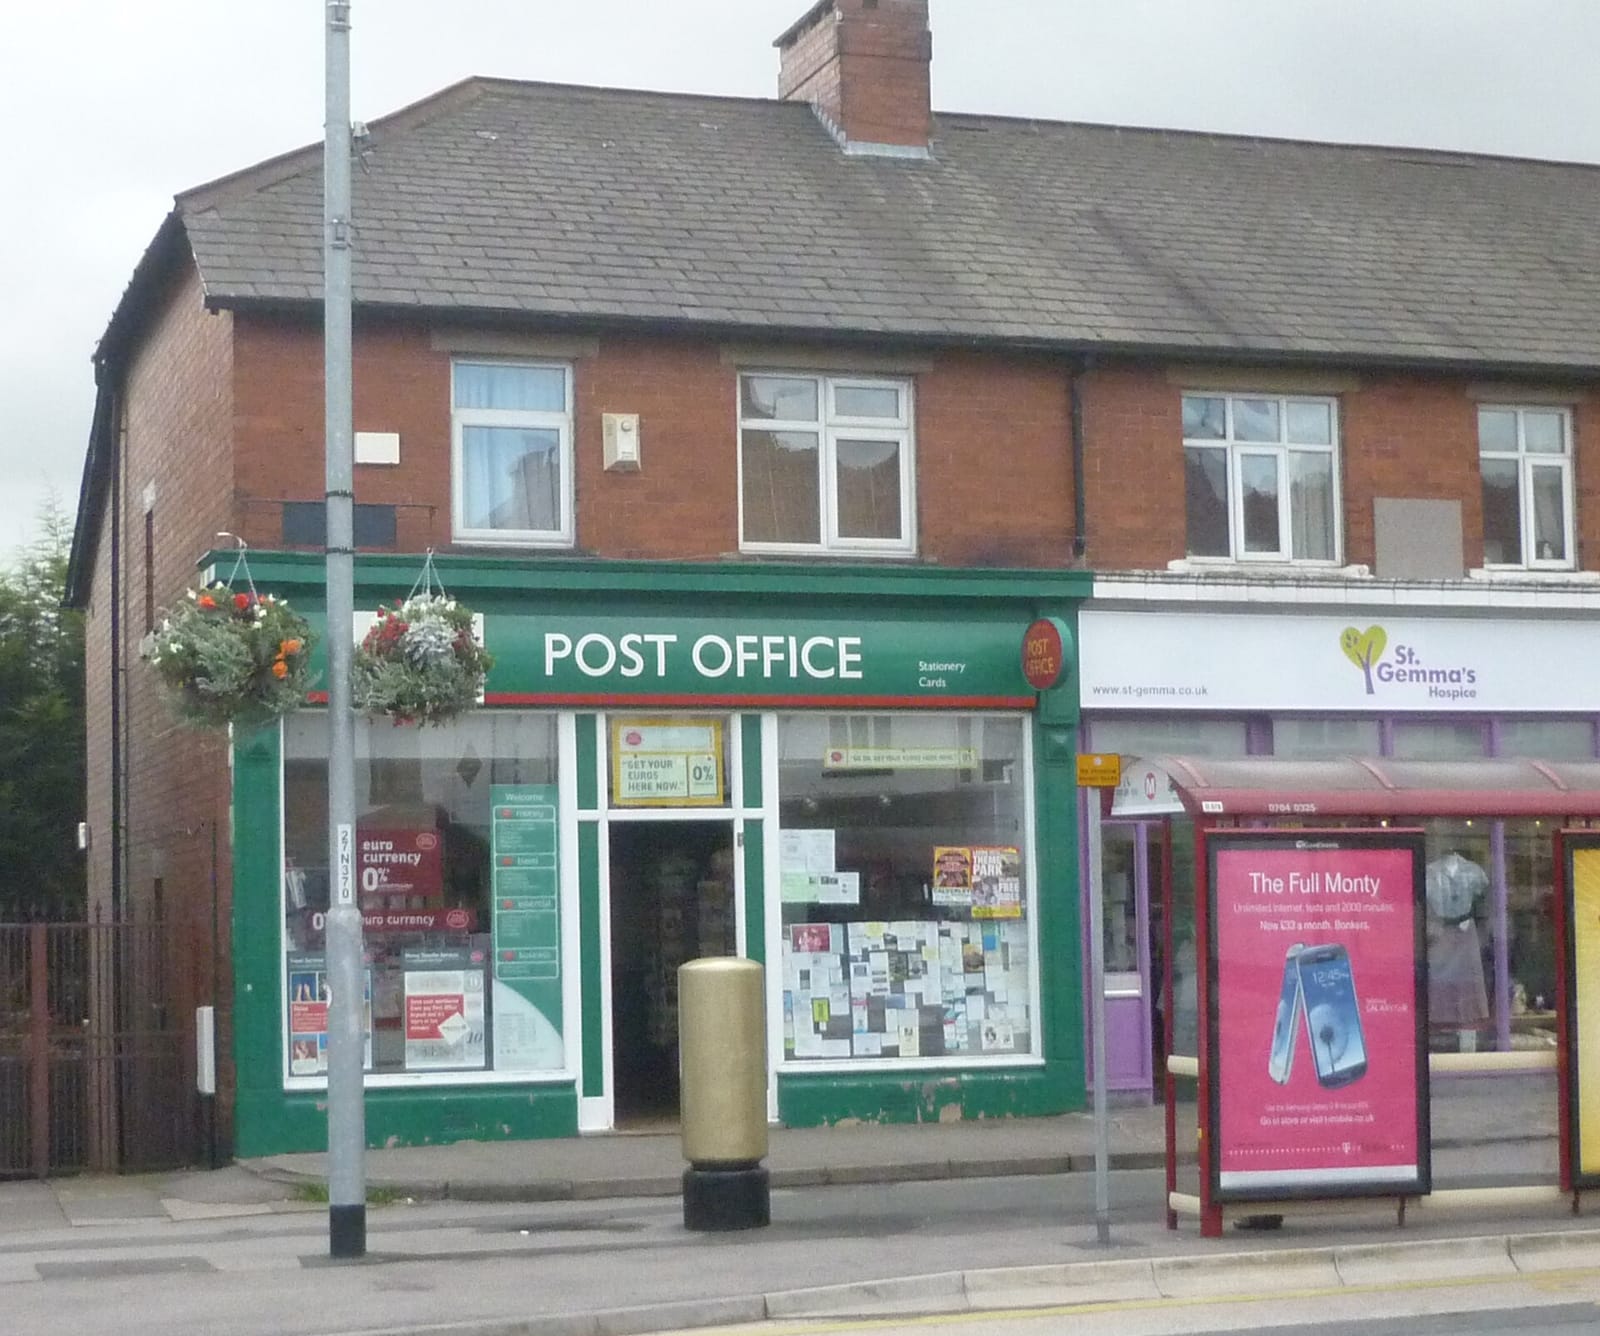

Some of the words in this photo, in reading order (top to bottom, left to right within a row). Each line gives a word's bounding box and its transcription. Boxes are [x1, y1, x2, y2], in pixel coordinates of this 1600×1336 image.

[1027, 639, 1049, 656] POST
[1394, 644, 1421, 665] St.
[544, 633, 678, 677] POST
[692, 634, 863, 679] OFFICE
[918, 660, 966, 674] Stationery
[1025, 656, 1056, 676] OFFICE
[1376, 662, 1476, 684] Gemma's
[918, 676, 947, 688] Cards
[1092, 685, 1208, 698] www.st-gemma.co.uk
[1428, 685, 1477, 701] Hospice
[649, 759, 673, 769] YOUR
[627, 771, 659, 780] EUROS
[692, 765, 714, 781] 0%
[627, 781, 654, 792] HERE
[504, 792, 544, 801] Welcome
[363, 840, 393, 851] euro
[363, 852, 422, 867] currency
[973, 864, 1002, 876] PARK
[1248, 872, 1284, 894] The
[1289, 872, 1320, 894] Full
[1325, 871, 1380, 897] Monty
[362, 915, 384, 926] uro
[387, 915, 435, 927] currency
